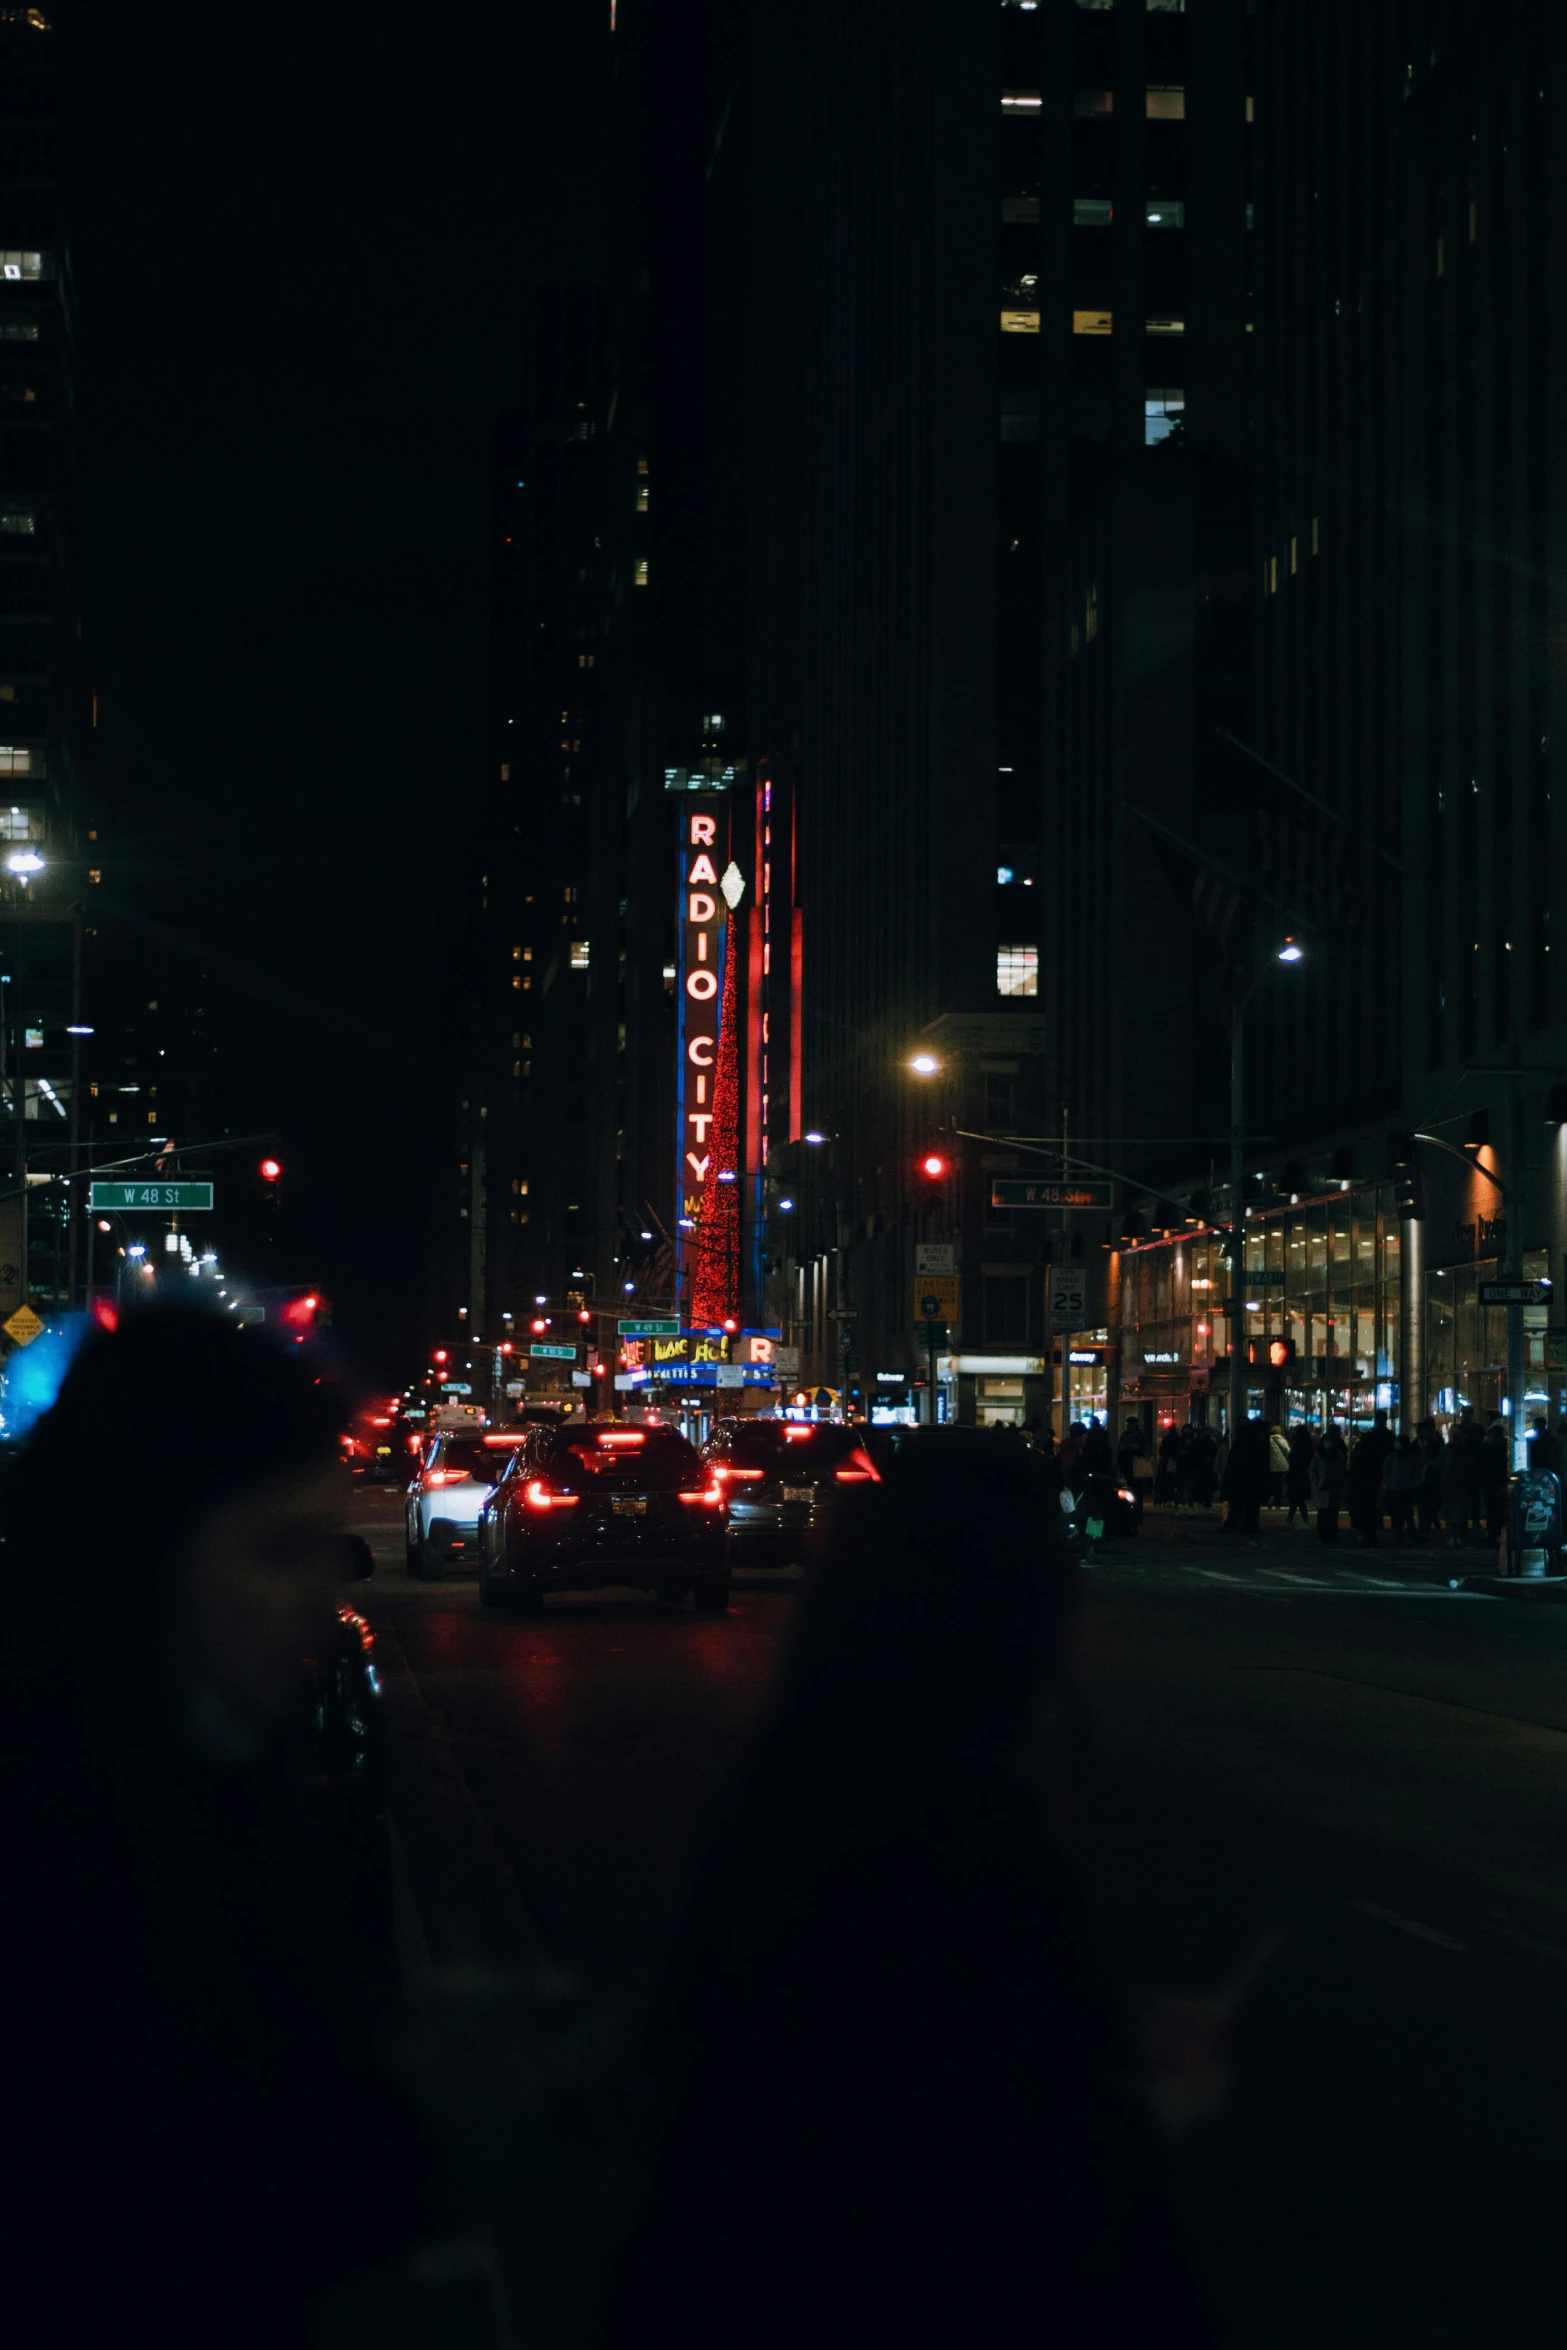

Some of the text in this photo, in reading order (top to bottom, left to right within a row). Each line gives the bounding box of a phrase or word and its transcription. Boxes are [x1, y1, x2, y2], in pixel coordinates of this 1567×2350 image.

[686, 815, 718, 1001] RADIO
[686, 1035, 714, 1182] CITY
[124, 1188, 180, 1204] W 48 St
[1025, 1186, 1037, 1203] W
[1041, 1186, 1060, 1203] 48
[1054, 1292, 1082, 1310] 25
[1489, 1288, 1542, 1298] ONE WAY
[634, 1323, 664, 1332] W 49 St
